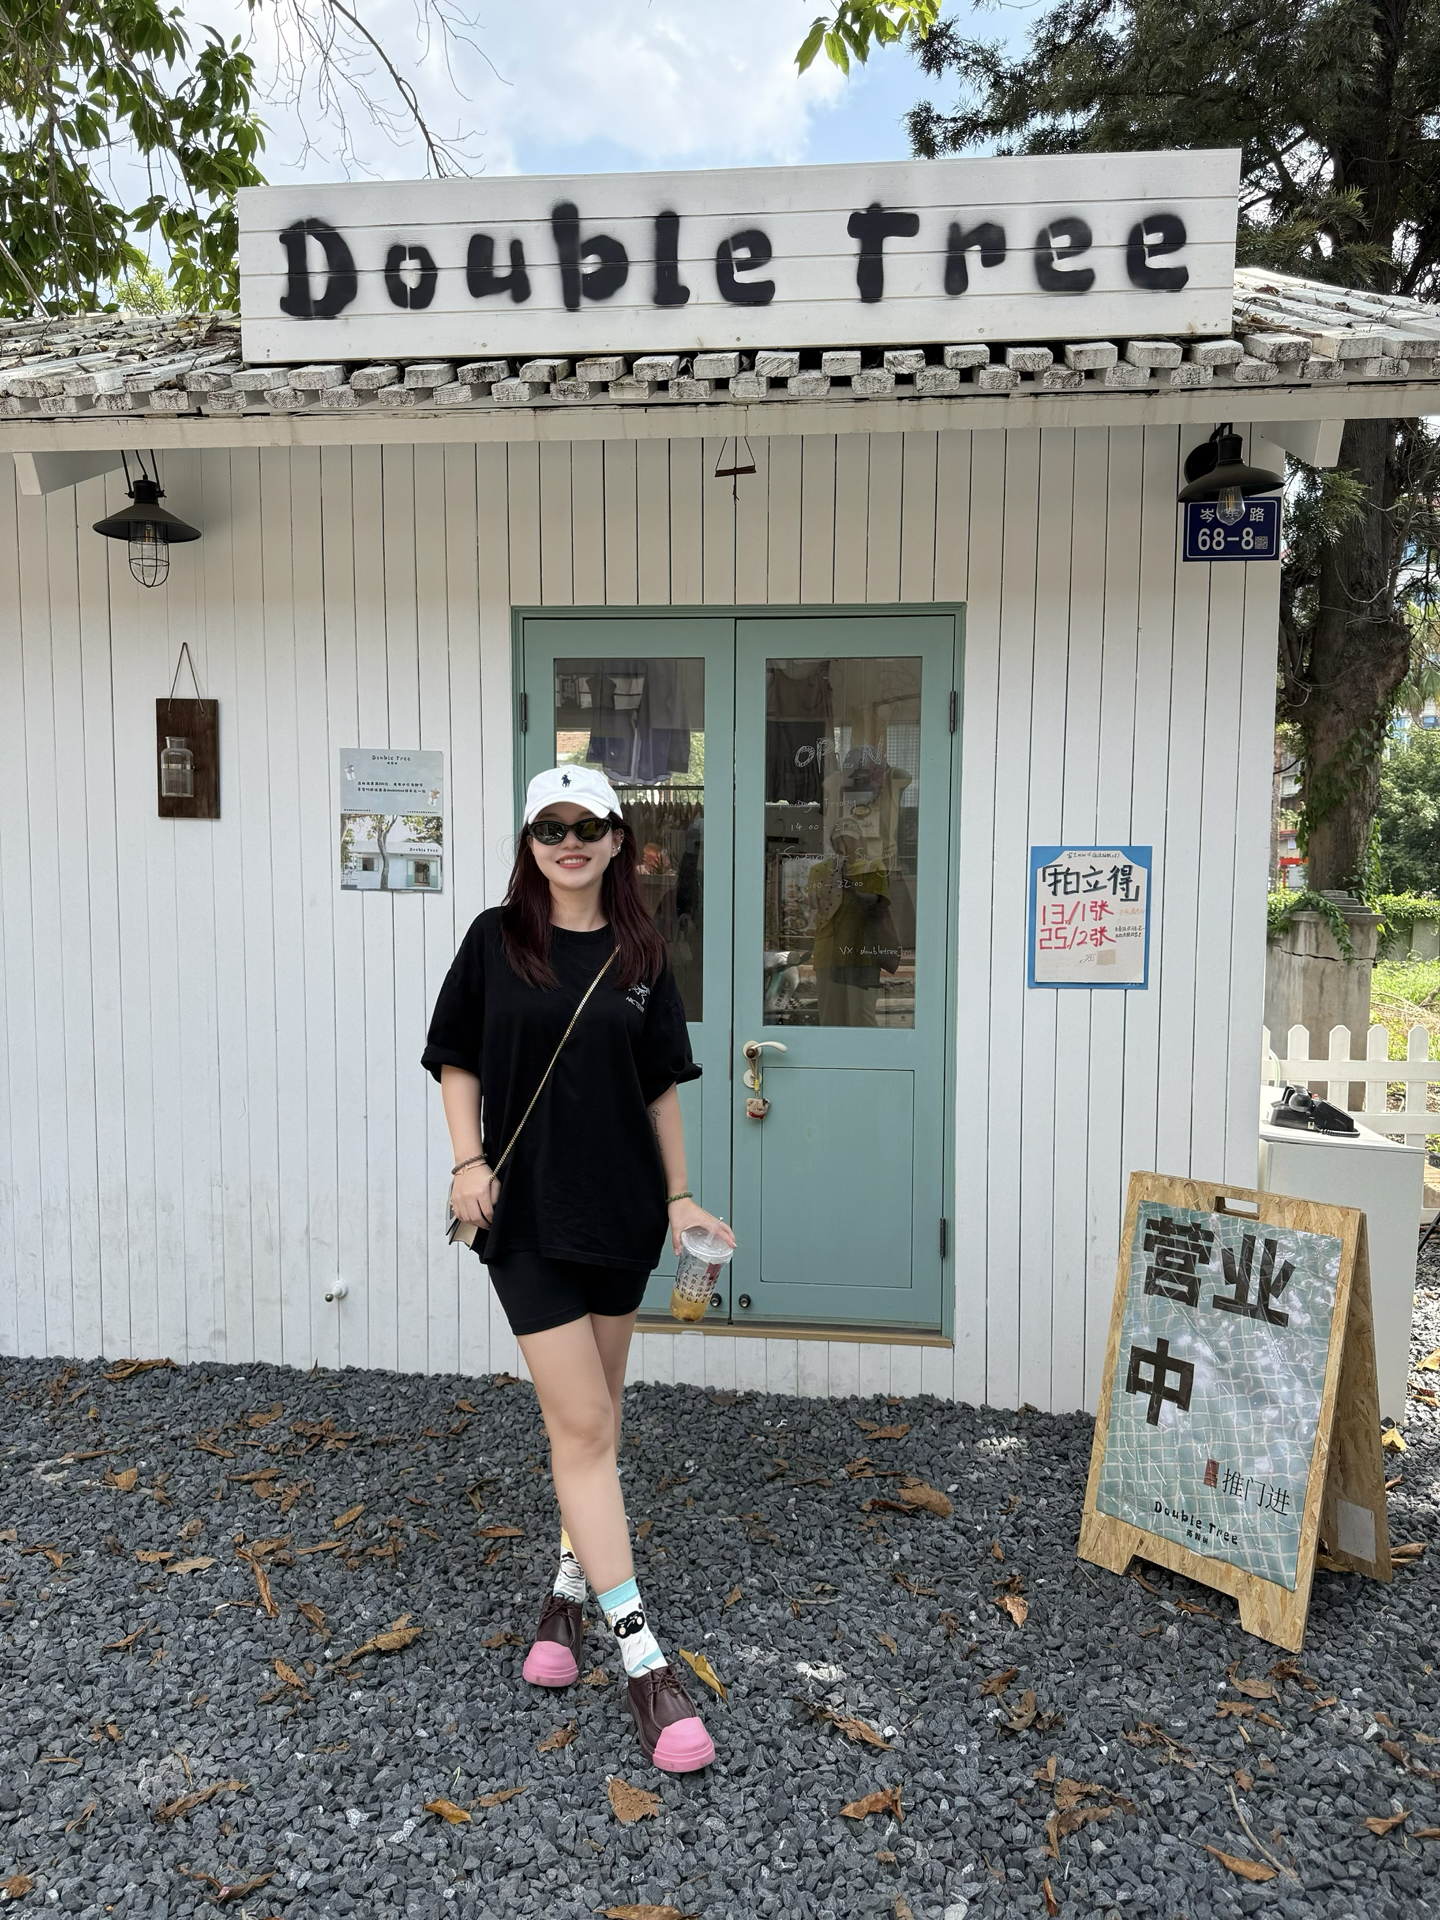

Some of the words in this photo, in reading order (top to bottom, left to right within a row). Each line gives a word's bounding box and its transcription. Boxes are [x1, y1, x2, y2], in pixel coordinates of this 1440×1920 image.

[280, 199, 775, 319] Double
[1197, 527, 1254, 551] 68-8
[836, 879, 864, 889] 22:00
[1143, 1216, 1296, 1327] 营业
[1125, 1337, 1195, 1427] 中
[1221, 1468, 1290, 1516] 推门进
[1154, 1501, 1202, 1529] Double
[1208, 1522, 1238, 1545] Tree
